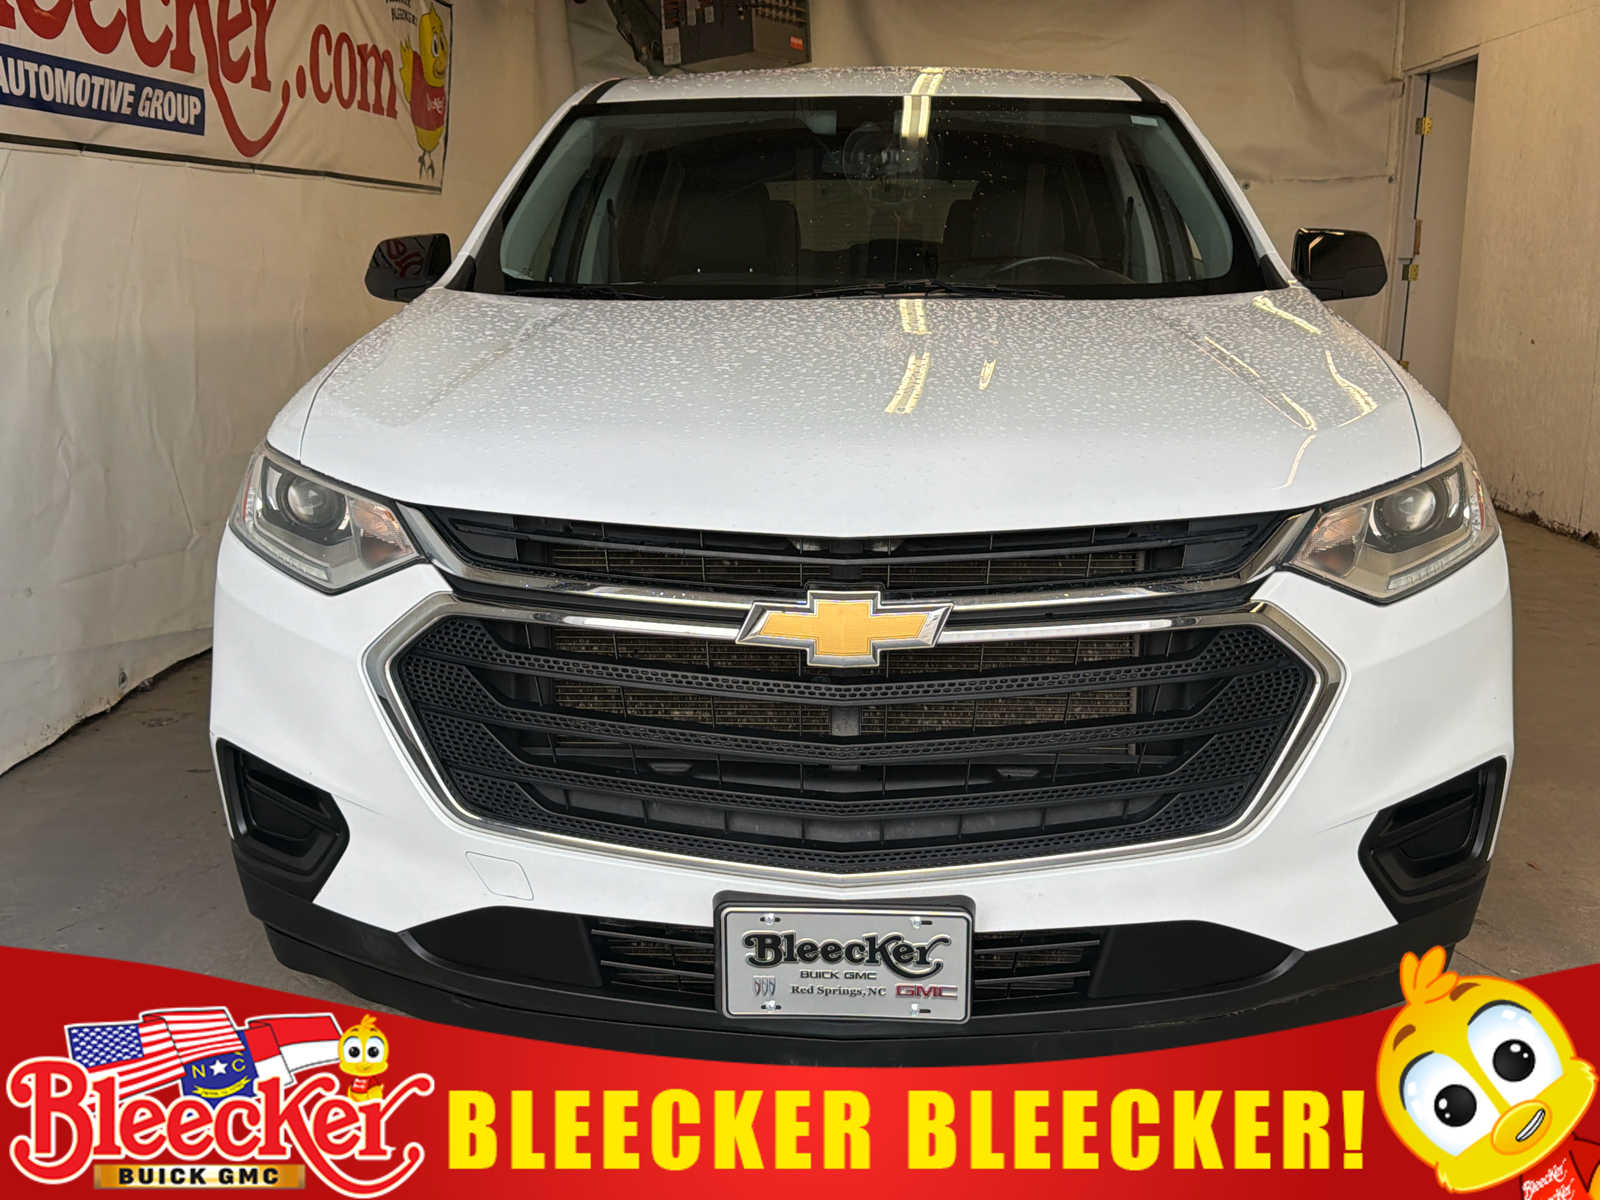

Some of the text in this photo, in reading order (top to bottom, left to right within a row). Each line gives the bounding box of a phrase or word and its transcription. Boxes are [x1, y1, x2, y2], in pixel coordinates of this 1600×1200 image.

[138, 86, 202, 126] GROUP
[743, 930, 951, 979] Bleecker
[800, 970, 877, 980] BUICK GMC
[791, 985, 814, 995] Red
[895, 984, 958, 999] GMC
